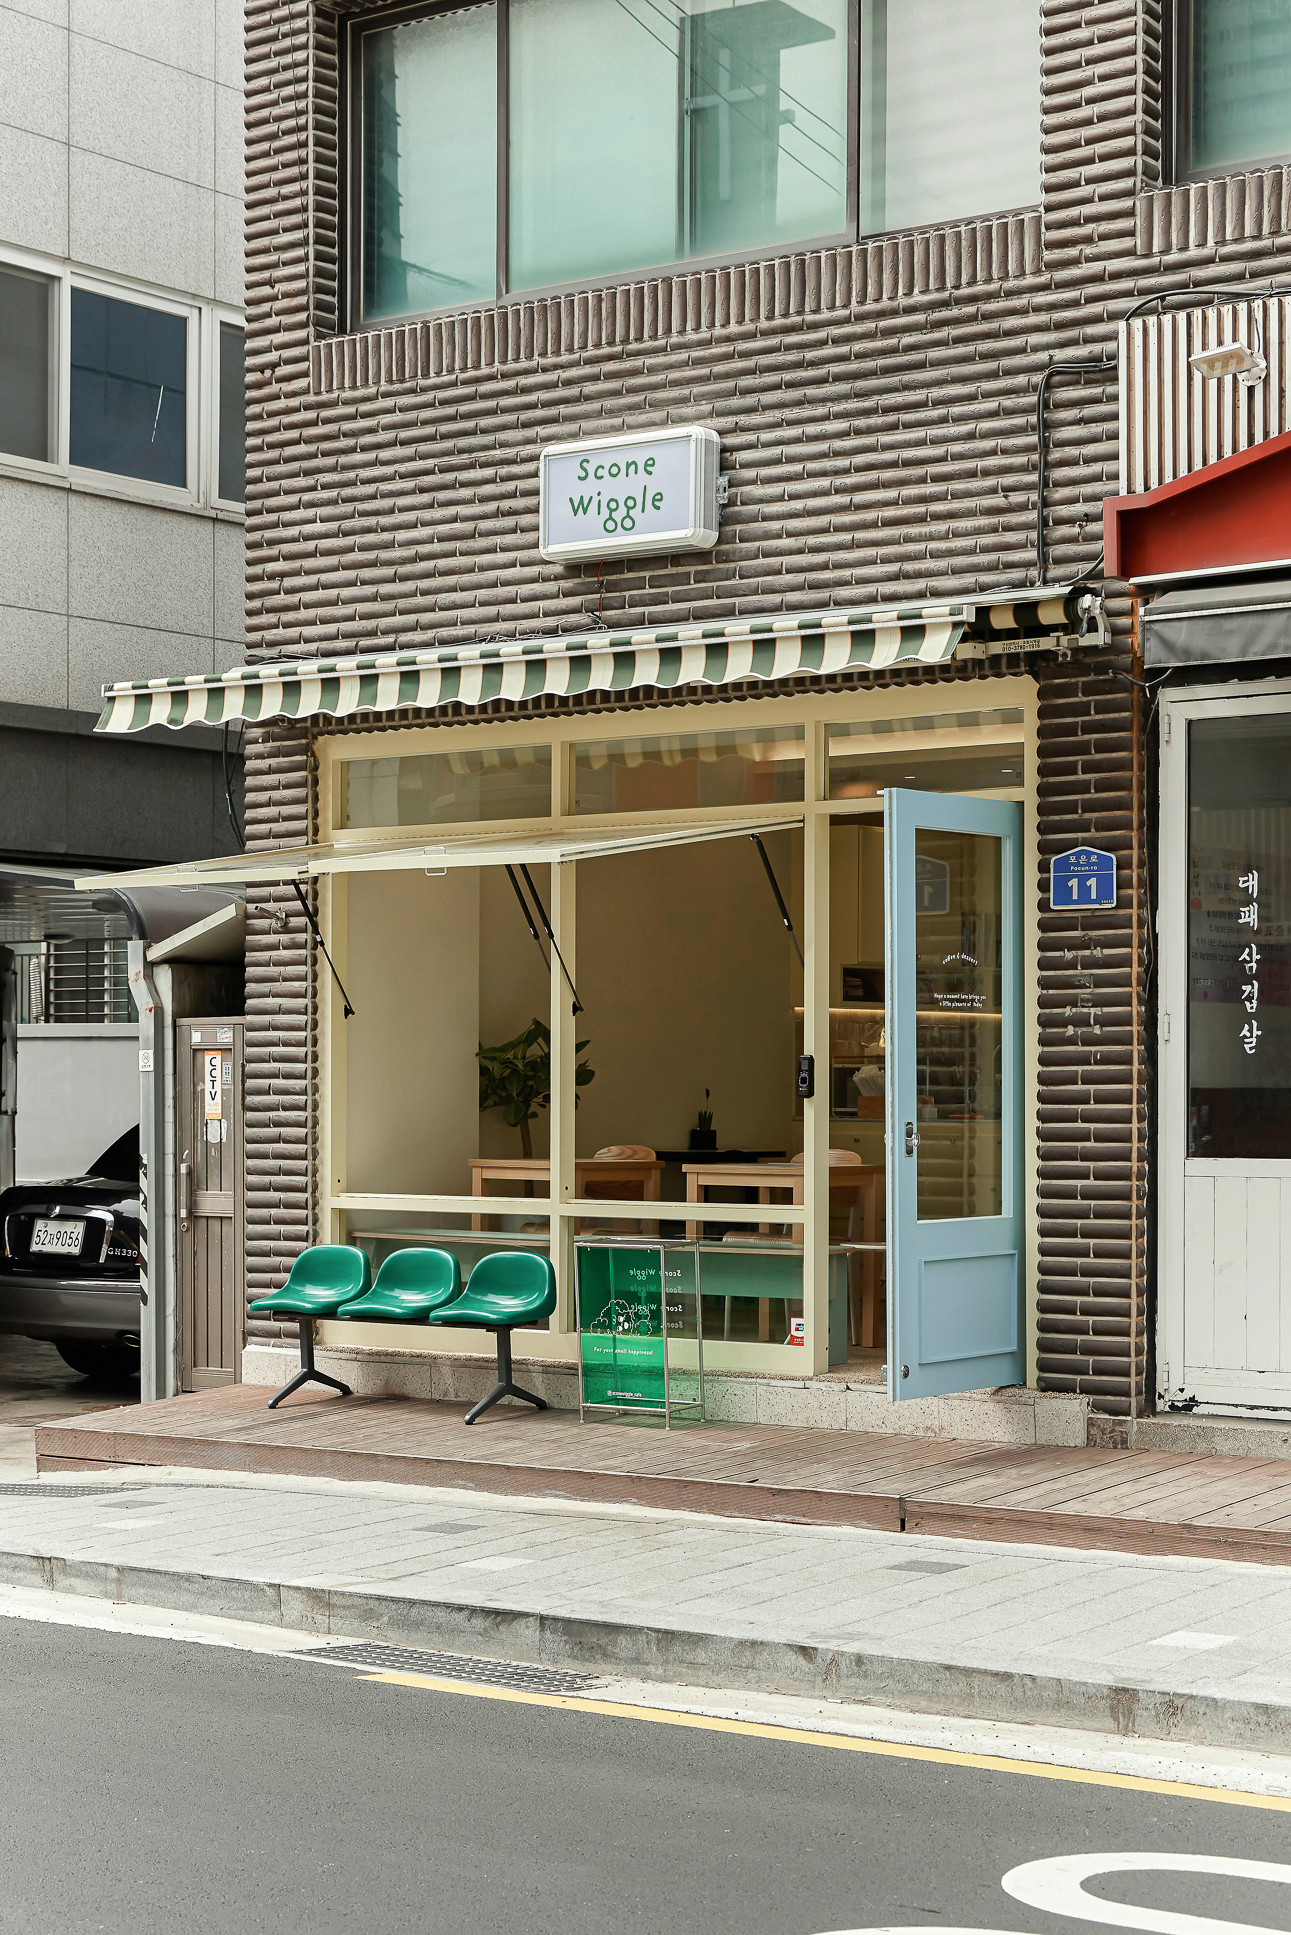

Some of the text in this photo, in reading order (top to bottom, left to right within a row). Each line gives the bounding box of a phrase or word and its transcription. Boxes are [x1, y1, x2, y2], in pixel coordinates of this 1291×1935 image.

[577, 456, 656, 481] Scone
[568, 485, 664, 534] Wiggle
[1068, 854, 1099, 865] 포은로
[1067, 877, 1097, 900] 11
[1237, 869, 1259, 931] 대패
[209, 1056, 217, 1101] CCTV
